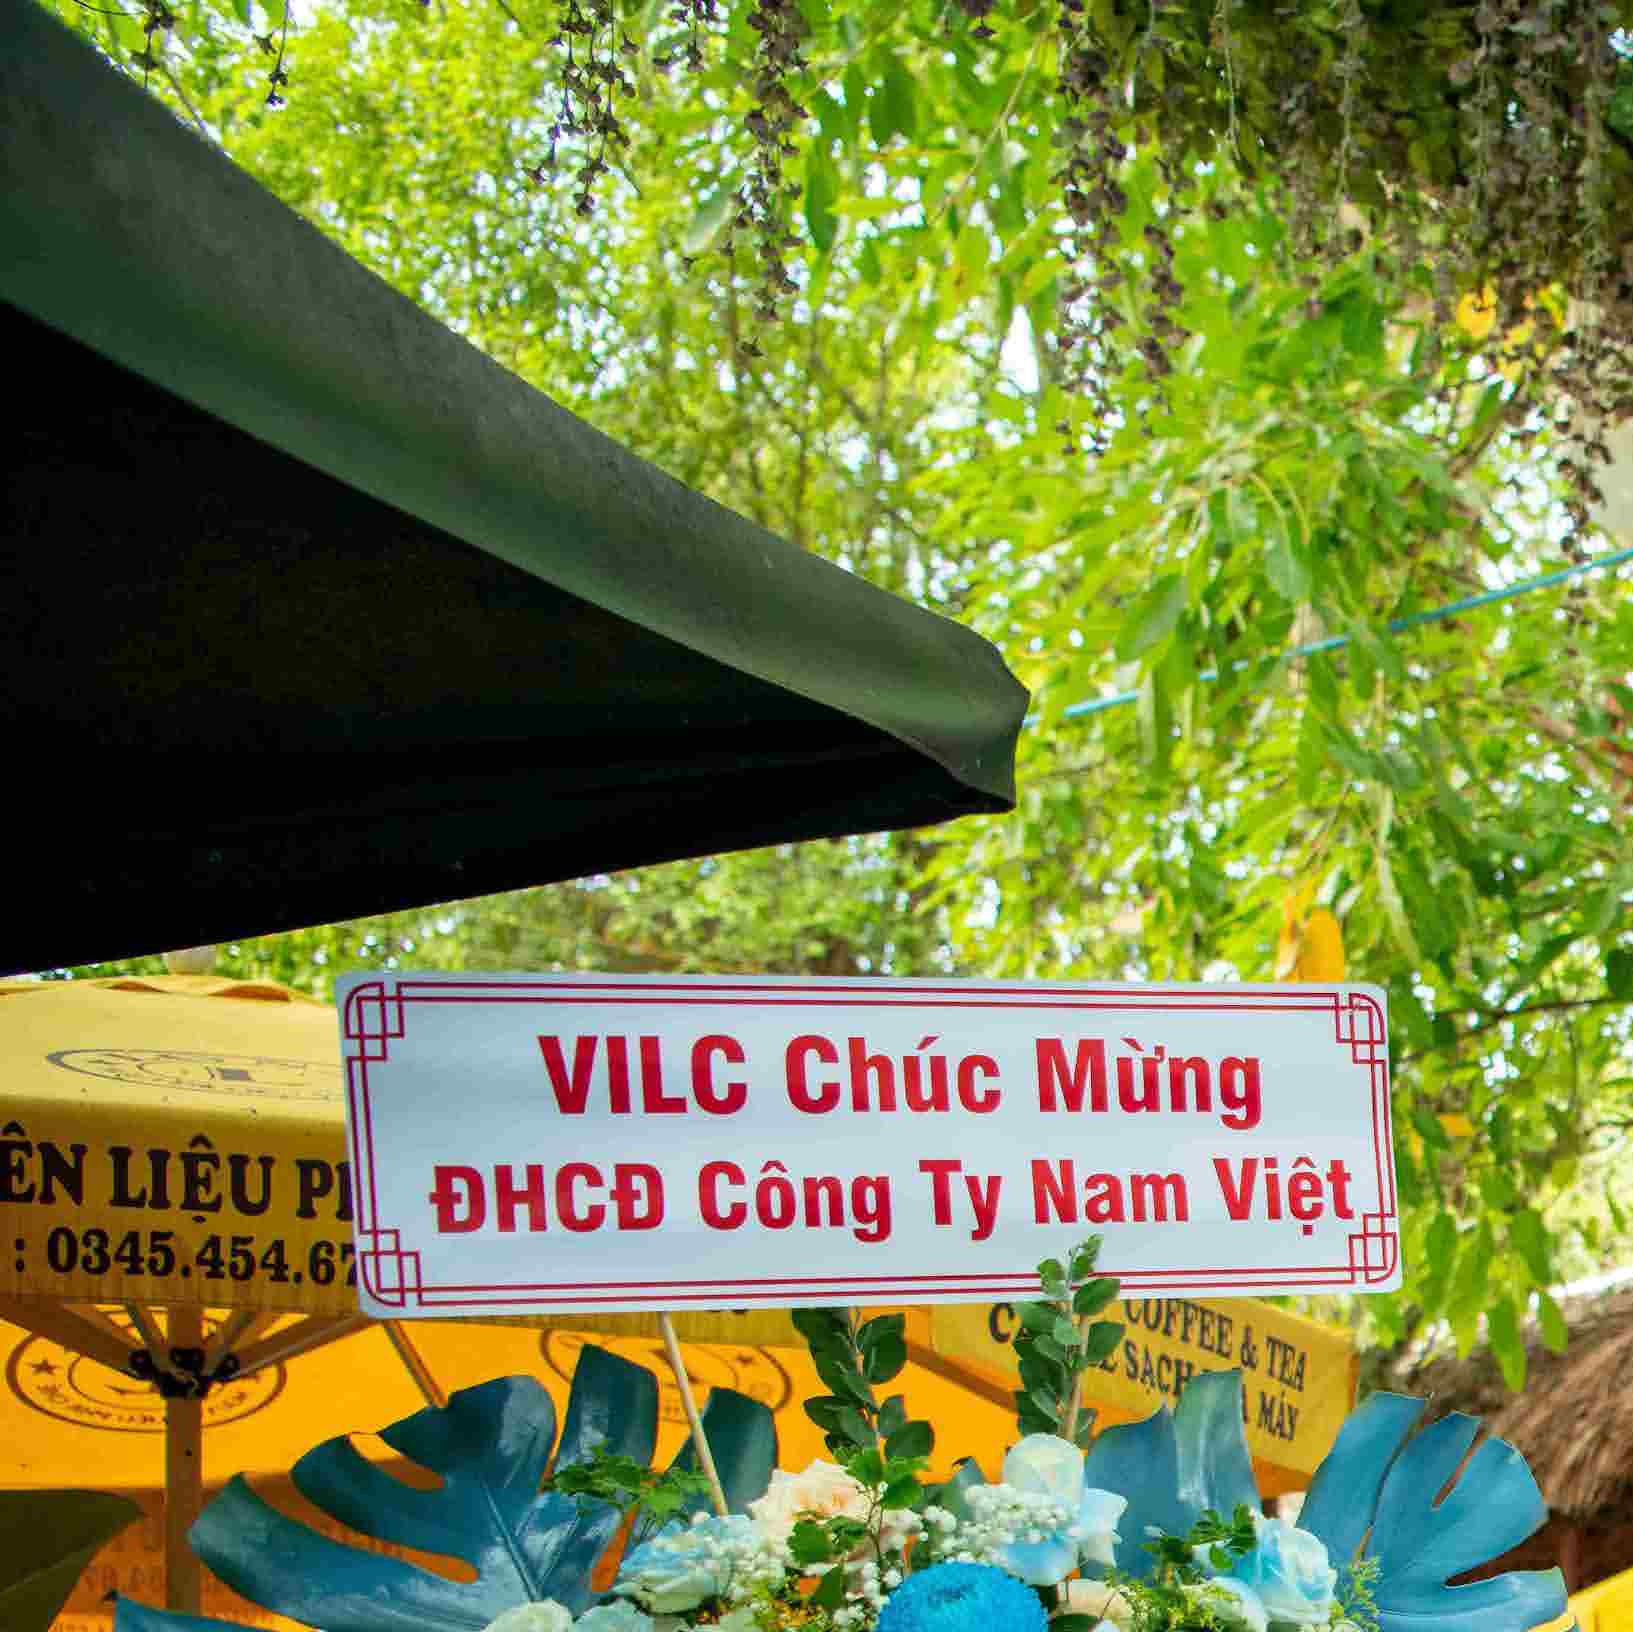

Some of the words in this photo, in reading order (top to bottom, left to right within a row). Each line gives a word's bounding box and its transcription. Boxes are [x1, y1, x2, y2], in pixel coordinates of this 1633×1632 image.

[539, 1034, 748, 1115] VILC
[784, 1033, 1001, 1114] Chúc
[1034, 1036, 1263, 1130] Mừng
[106, 1133, 276, 1224] LIỆU
[430, 1163, 665, 1234] ĐHCĐ
[698, 1160, 891, 1244] Công
[919, 1159, 1002, 1242] Ty
[1031, 1159, 1188, 1226] Nam
[1212, 1157, 1354, 1236] Việt
[1124, 1298, 1233, 1359] COFFEE
[1239, 1326, 1257, 1370] &
[1265, 1335, 1308, 1392] TEA
[1124, 1338, 1194, 1398] SẠCH
[1258, 1390, 1299, 1441] MÁY
